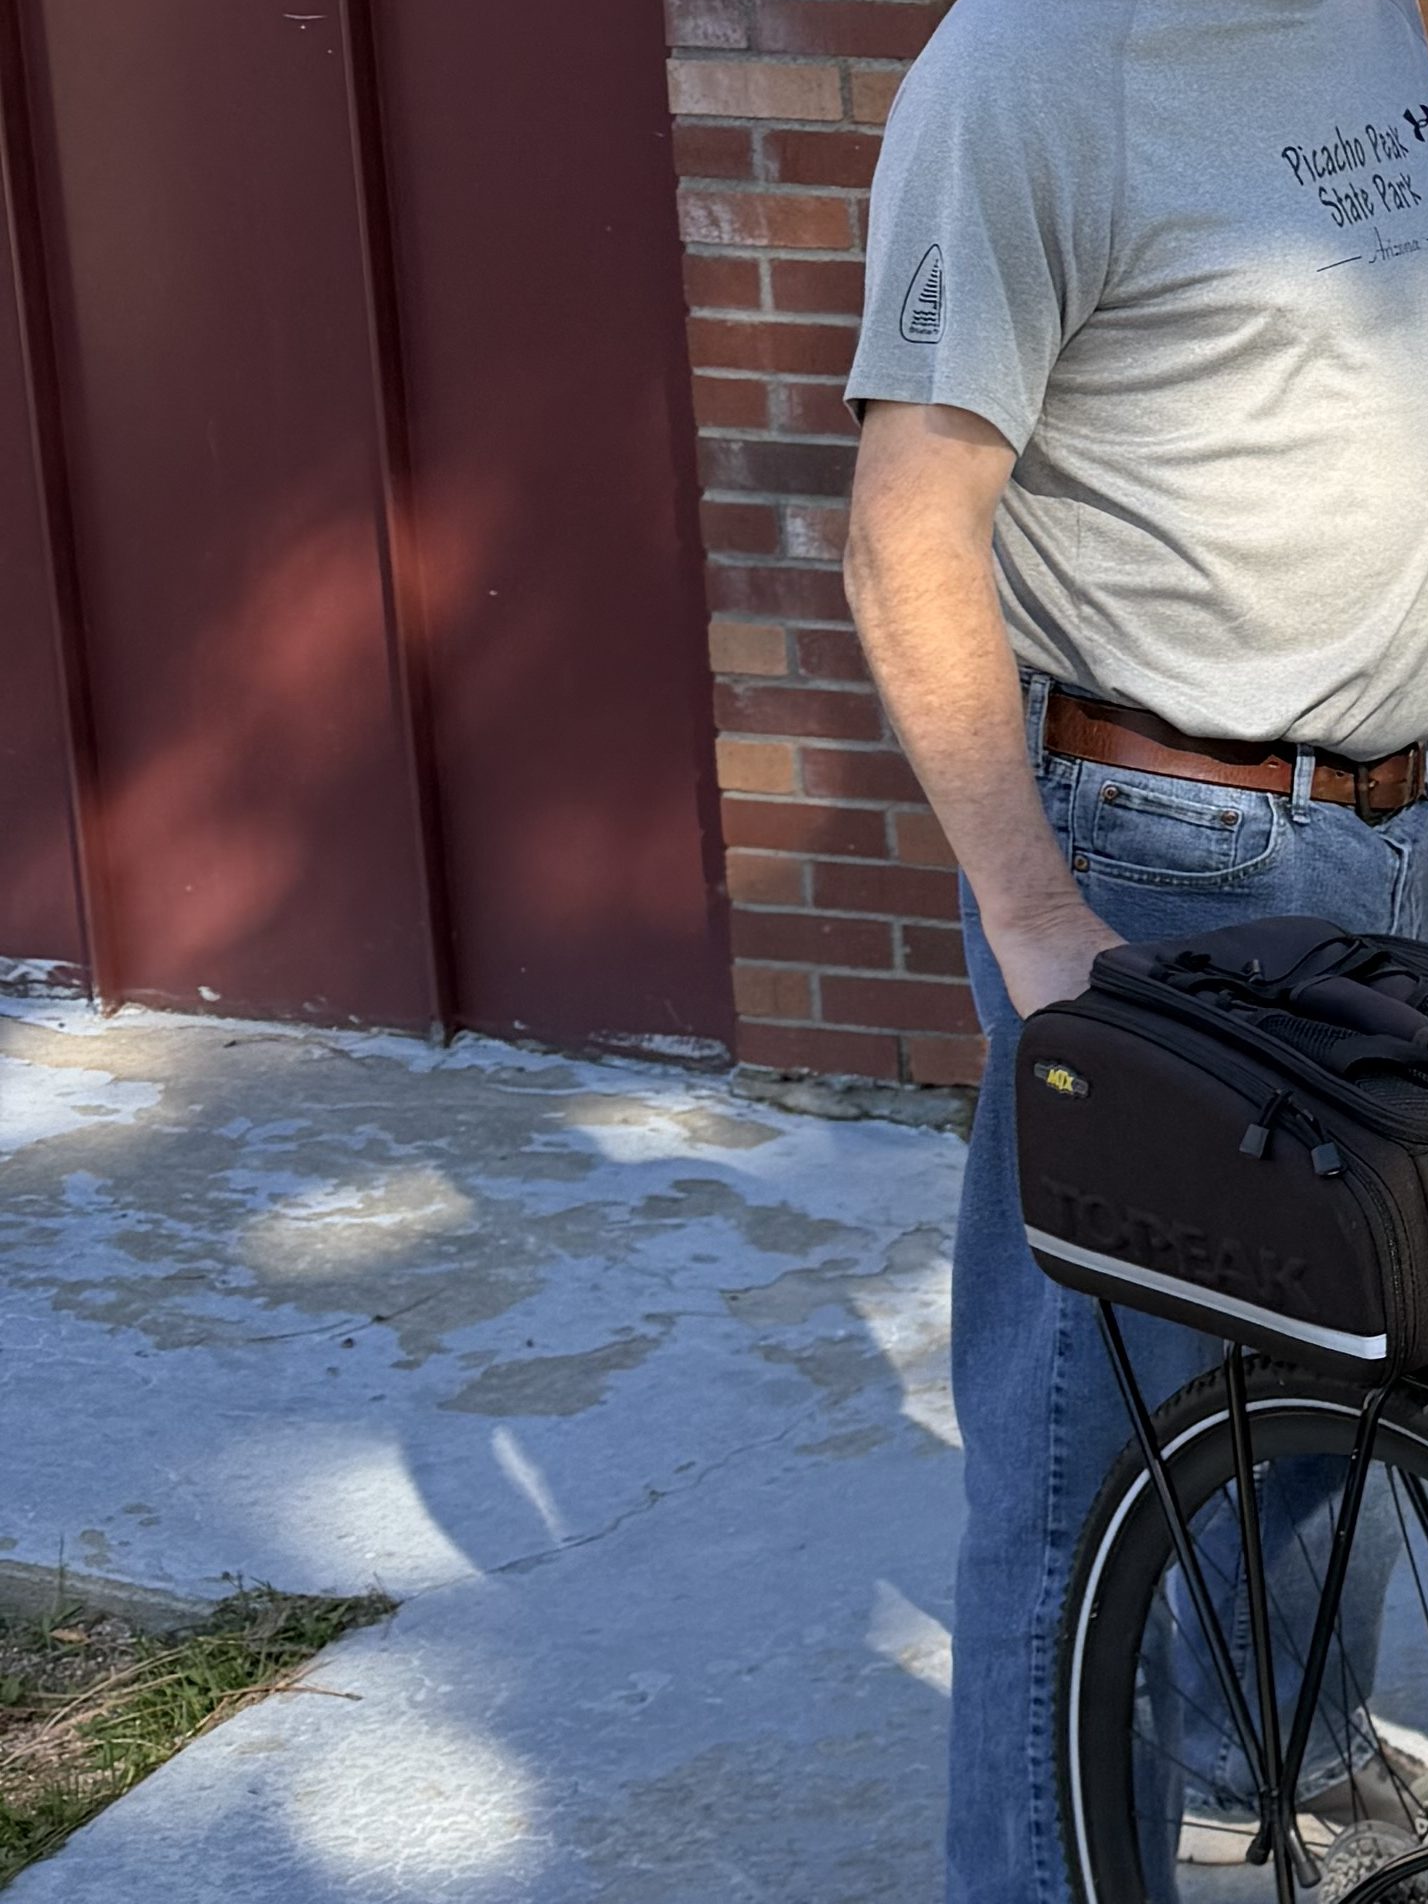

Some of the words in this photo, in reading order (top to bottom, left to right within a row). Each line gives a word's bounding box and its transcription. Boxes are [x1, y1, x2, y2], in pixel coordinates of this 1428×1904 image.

[1281, 126, 1366, 186] Picacho
[1365, 124, 1409, 163] Peak
[1318, 182, 1375, 228] State
[1372, 172, 1422, 213] Park
